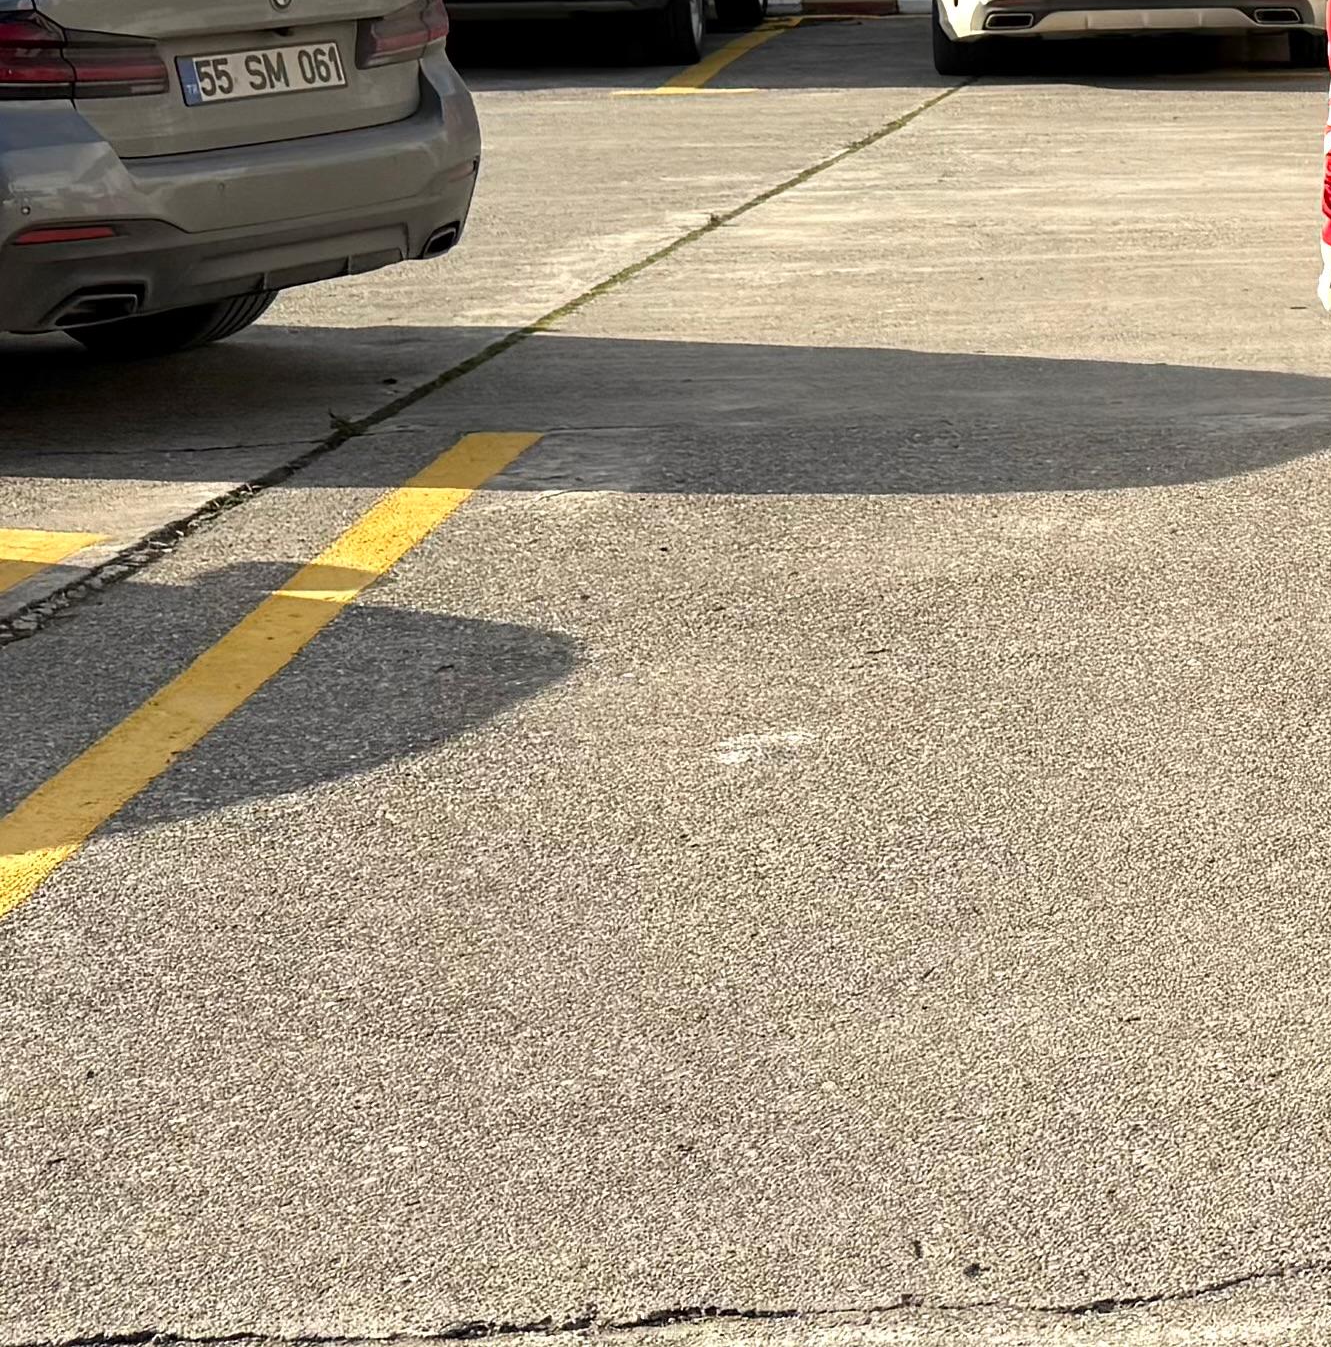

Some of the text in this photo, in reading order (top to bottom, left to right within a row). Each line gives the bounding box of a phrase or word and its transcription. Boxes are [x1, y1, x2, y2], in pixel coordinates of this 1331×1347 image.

[195, 58, 234, 96] 55
[244, 51, 290, 91] SM
[298, 46, 343, 84] 061
